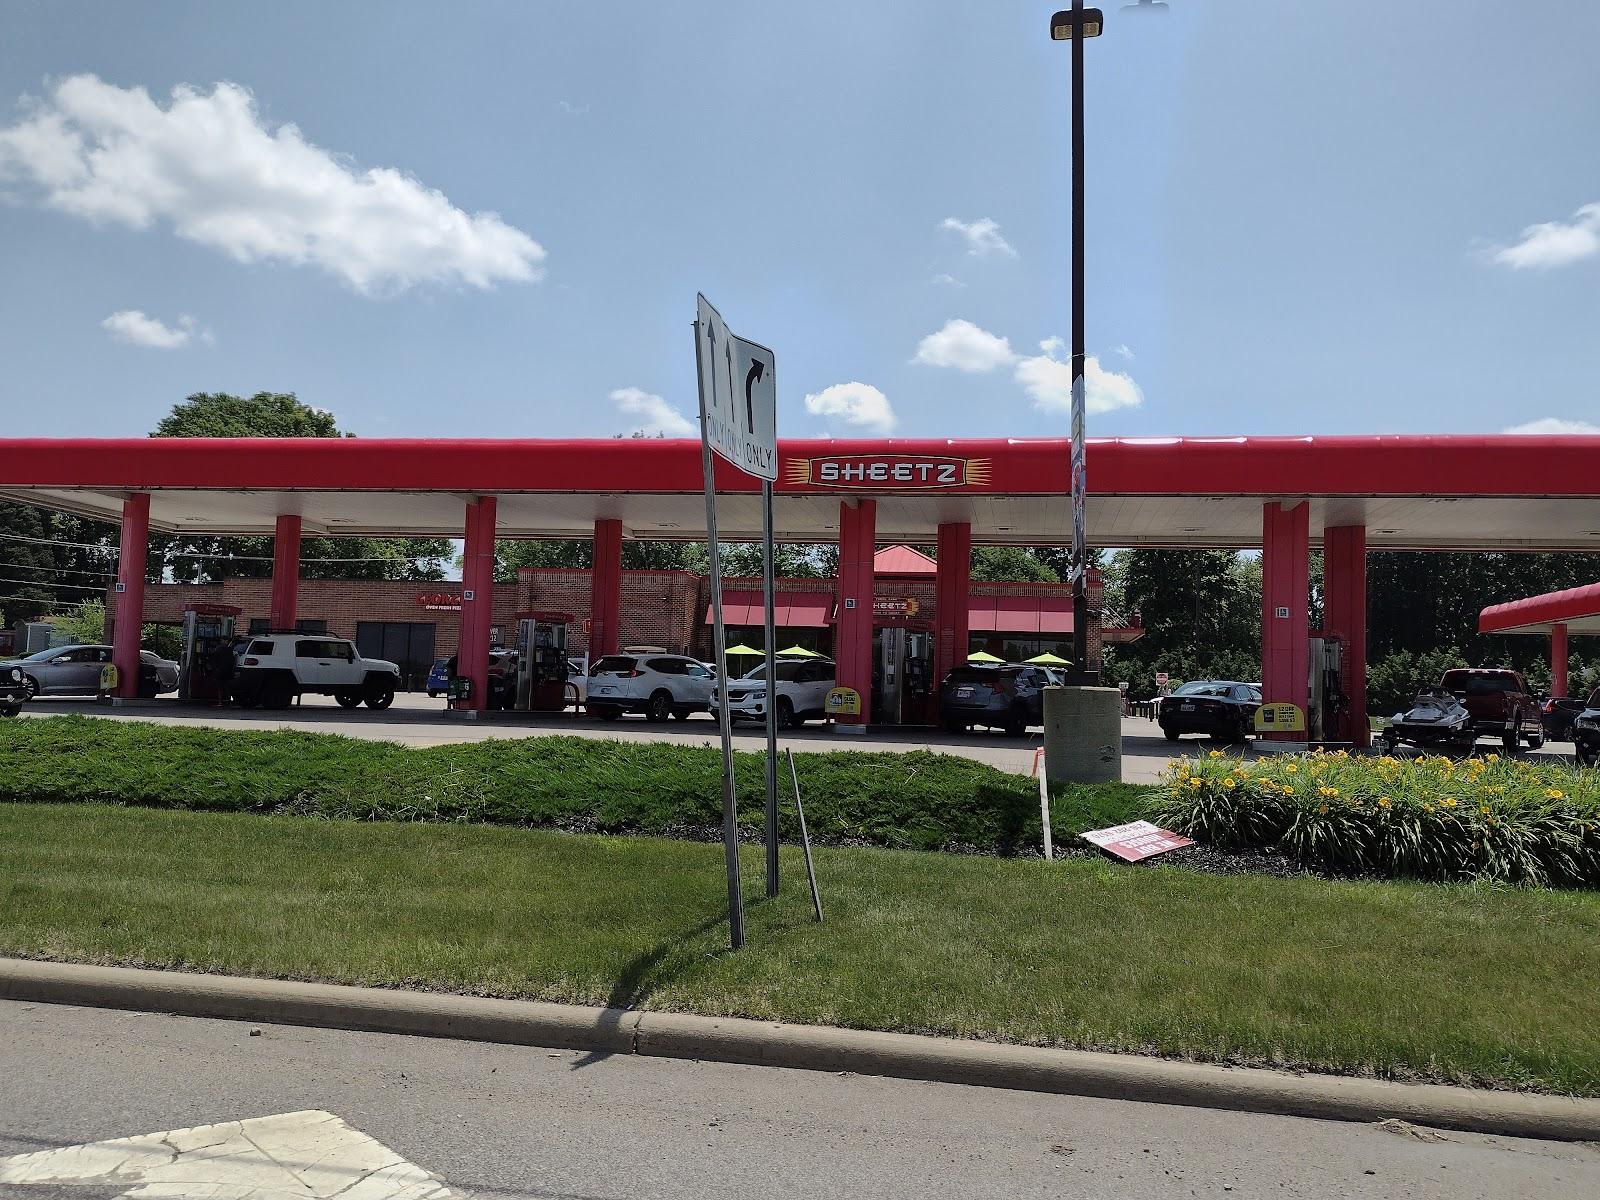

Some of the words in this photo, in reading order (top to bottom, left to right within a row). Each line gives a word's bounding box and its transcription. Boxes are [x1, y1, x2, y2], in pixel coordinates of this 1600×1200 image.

[746, 442, 772, 470] ONLY
[820, 462, 957, 483] SHEETZ
[415, 592, 461, 605] GEORG
[872, 602, 908, 610] HEETZ
